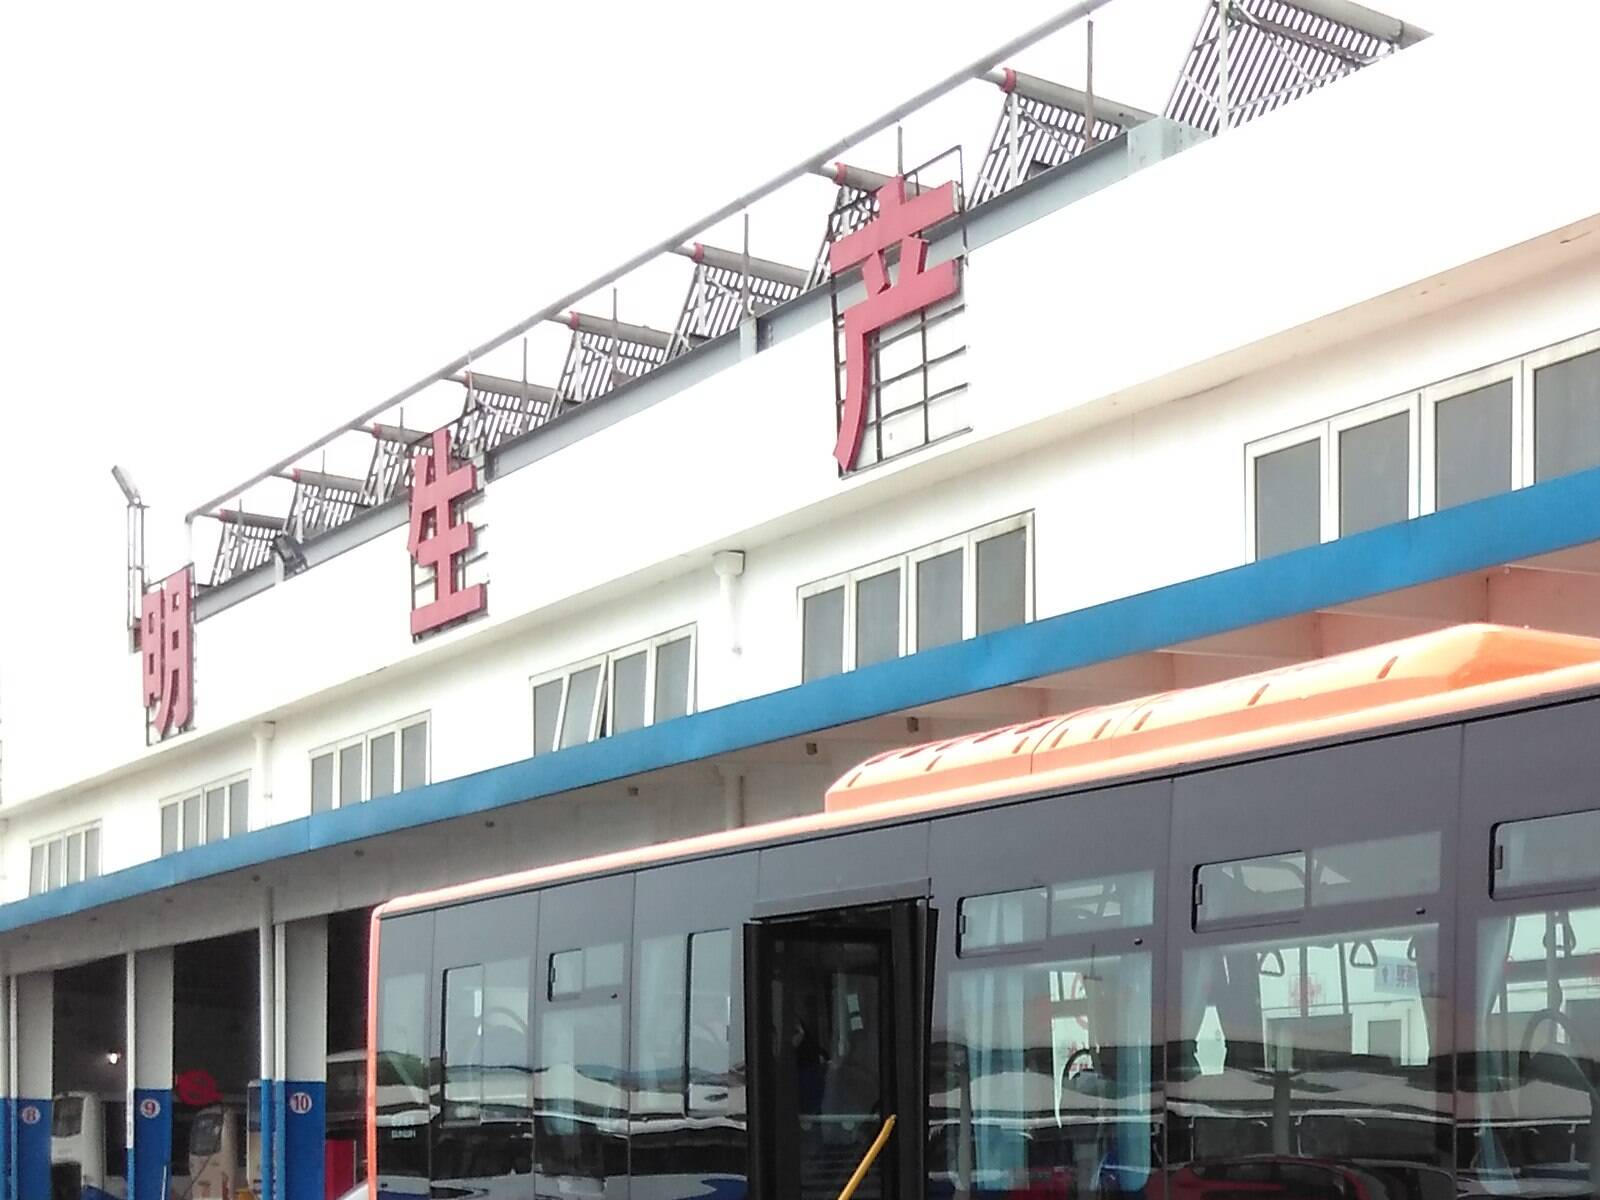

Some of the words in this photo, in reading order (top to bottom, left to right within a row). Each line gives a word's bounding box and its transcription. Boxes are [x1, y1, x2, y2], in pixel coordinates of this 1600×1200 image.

[142, 566, 194, 735] 明
[408, 428, 487, 636] 生
[830, 175, 958, 471] 产
[294, 1094, 310, 1111] 10
